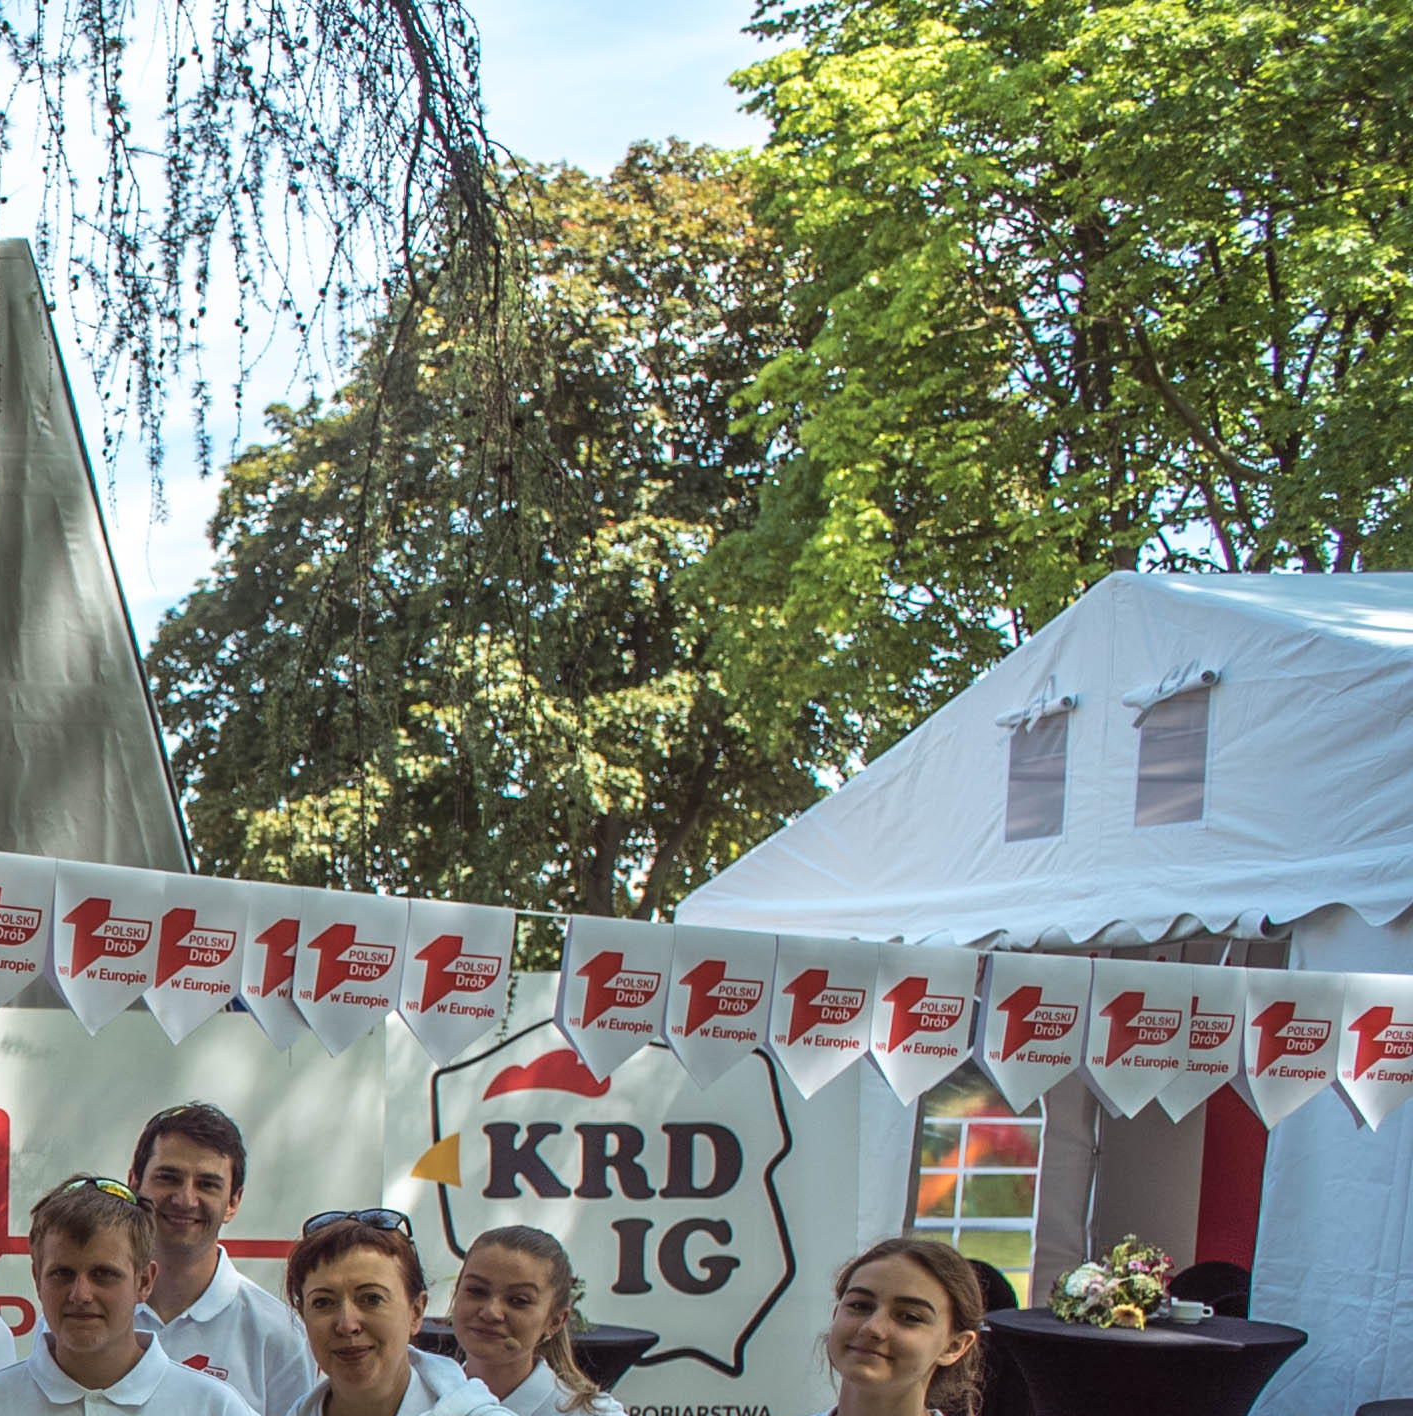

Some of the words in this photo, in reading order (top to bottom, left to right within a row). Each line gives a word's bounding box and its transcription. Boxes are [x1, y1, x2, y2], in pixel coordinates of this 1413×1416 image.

[103, 924, 145, 938] POLSKI
[105, 937, 138, 953] Drób
[188, 934, 229, 948] POLSKI
[189, 947, 222, 963] Drób
[348, 949, 389, 963] POLSKI
[348, 962, 381, 978] Drób
[454, 960, 495, 974] POLSKI
[86, 969, 97, 978] w
[99, 968, 146, 985] Europie
[455, 972, 487, 988] Drób
[615, 976, 654, 990] POLSKI
[170, 979, 181, 988] w
[182, 977, 230, 994] Europie
[717, 985, 757, 998] POLSKI
[329, 993, 340, 1002] w
[342, 992, 389, 1009] Europie
[615, 989, 647, 1004] Drób
[820, 993, 859, 1006] POLSKI
[436, 1004, 447, 1013] w
[448, 1003, 494, 1020] Europie
[718, 997, 749, 1012] Drób
[919, 1001, 958, 1014] POLSKI
[820, 1005, 852, 1020] Drób
[920, 1012, 951, 1028] Drób
[1033, 1010, 1071, 1022] POLSKI
[596, 1019, 606, 1028] w
[608, 1018, 653, 1034] Europie
[1137, 1015, 1176, 1027] POLSKI
[699, 1028, 709, 1036] w
[711, 1026, 757, 1041] Europie
[1033, 1023, 1063, 1036] Drób
[1137, 1028, 1167, 1041] Drób
[802, 1036, 813, 1044] w
[814, 1034, 860, 1049] Europie
[902, 1044, 912, 1052] w
[913, 1043, 958, 1058] Europie
[1015, 1053, 1025, 1061] w
[1027, 1051, 1071, 1066] Europie
[1121, 1058, 1131, 1066] w
[1133, 1056, 1179, 1071] Europie
[482, 1123, 743, 1199] KRD
[611, 1218, 740, 1294] IG
